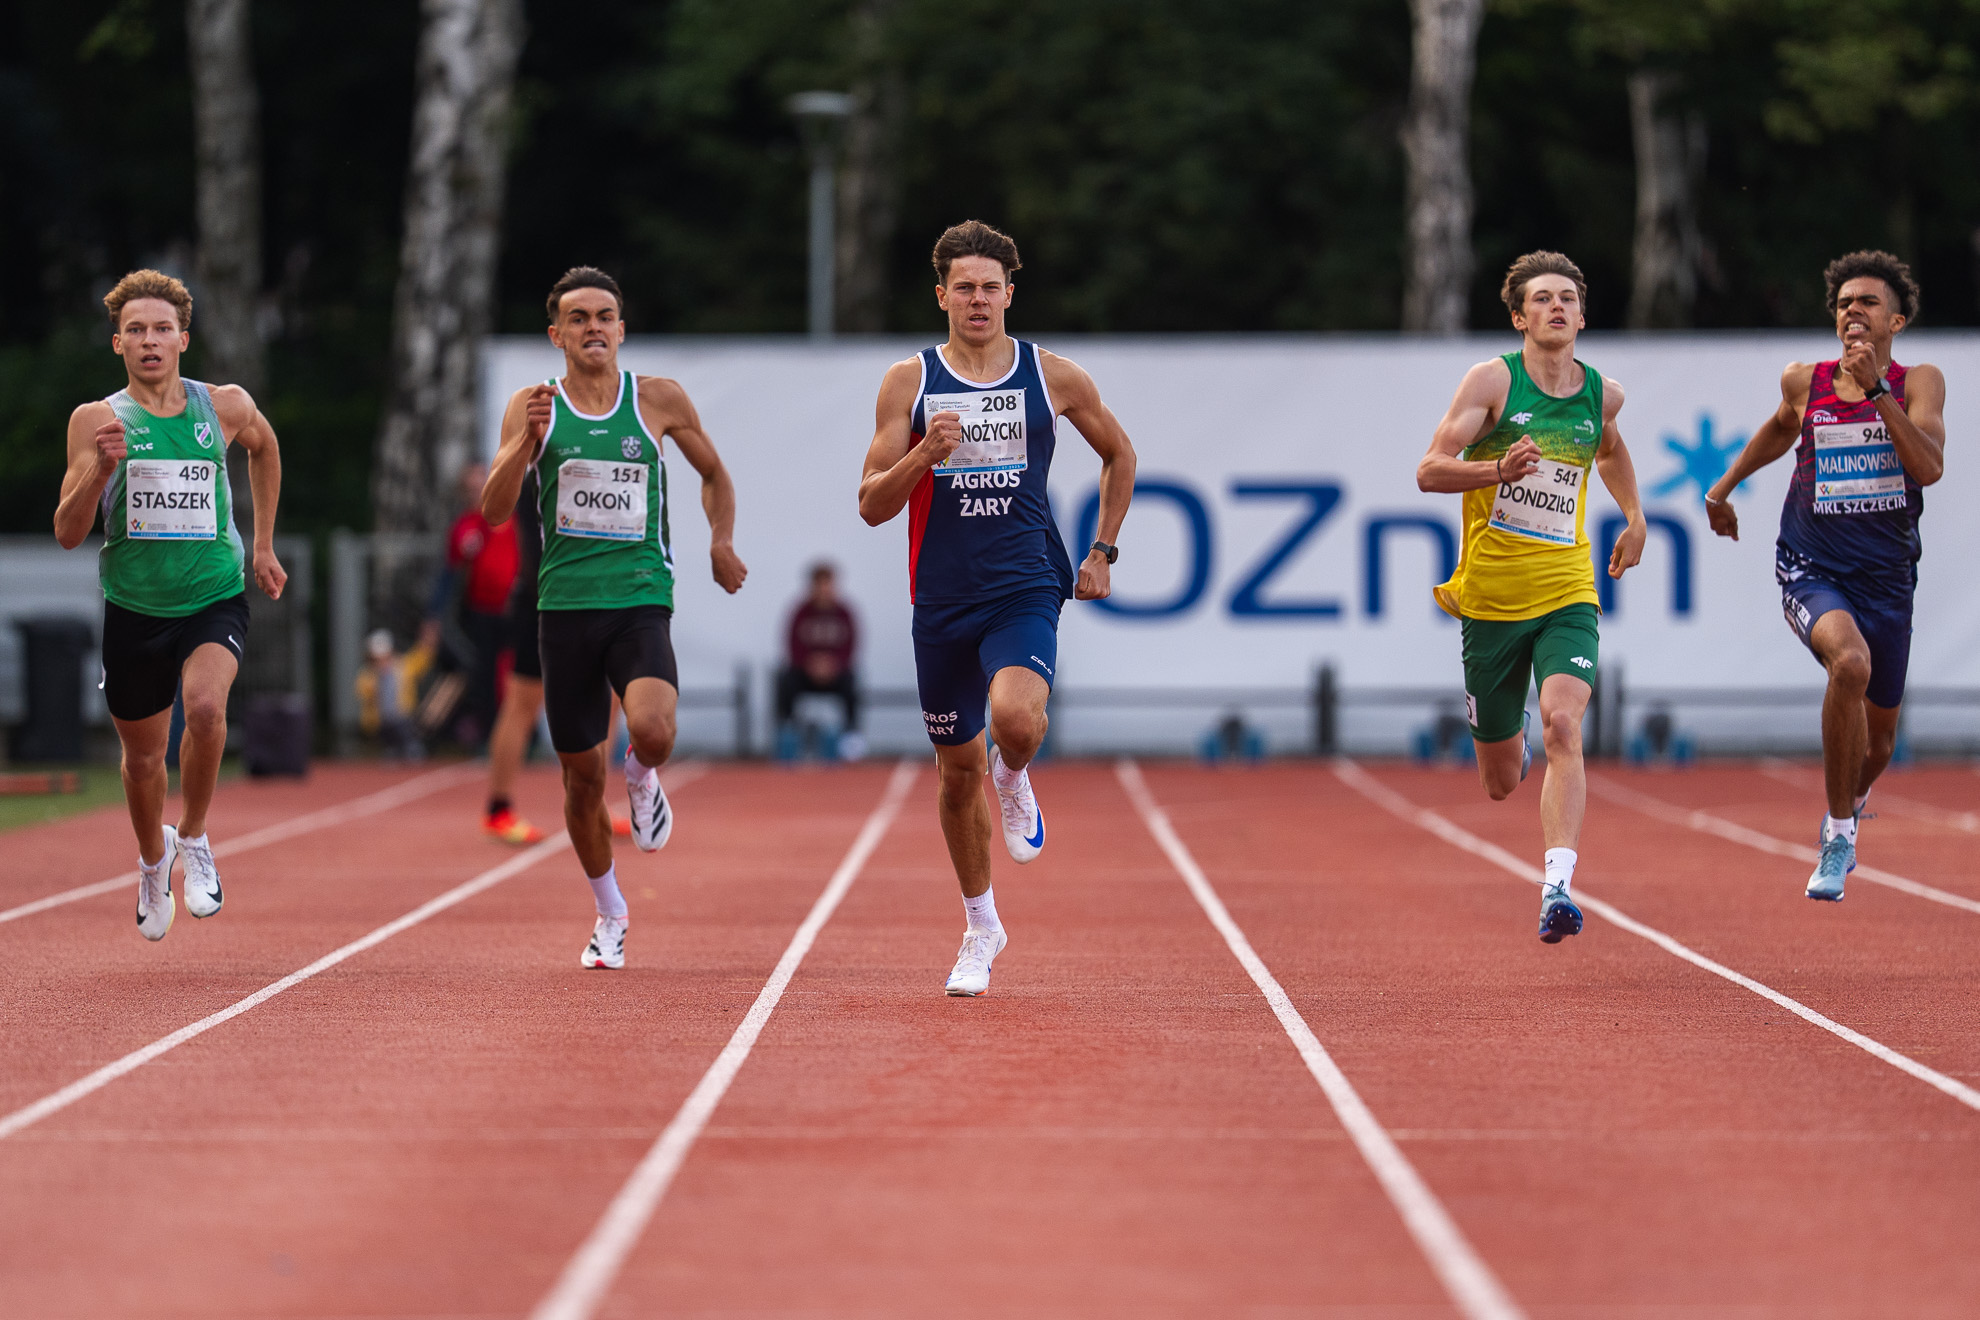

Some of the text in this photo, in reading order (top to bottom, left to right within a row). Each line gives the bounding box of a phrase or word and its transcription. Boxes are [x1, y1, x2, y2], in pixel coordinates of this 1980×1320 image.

[981, 395, 1017, 412] 208
[1510, 412, 1533, 425] 4F
[1813, 414, 1838, 423] Enea
[959, 418, 1022, 444] NOŻYCKI
[1818, 451, 1899, 475] MALINOWSKI
[179, 466, 209, 481] 450
[611, 467, 641, 483] 151
[951, 470, 1021, 489] AGROS
[1553, 467, 1578, 487] 541
[132, 491, 211, 510] STASZEK
[573, 490, 631, 511] OKOŃ
[960, 494, 1013, 517] ŻARY
[1499, 482, 1575, 515] DONDZIŁO
[1813, 496, 1907, 515] MKL SZCZECIN
[1570, 656, 1594, 669] 4F
[922, 710, 958, 722] GROS
